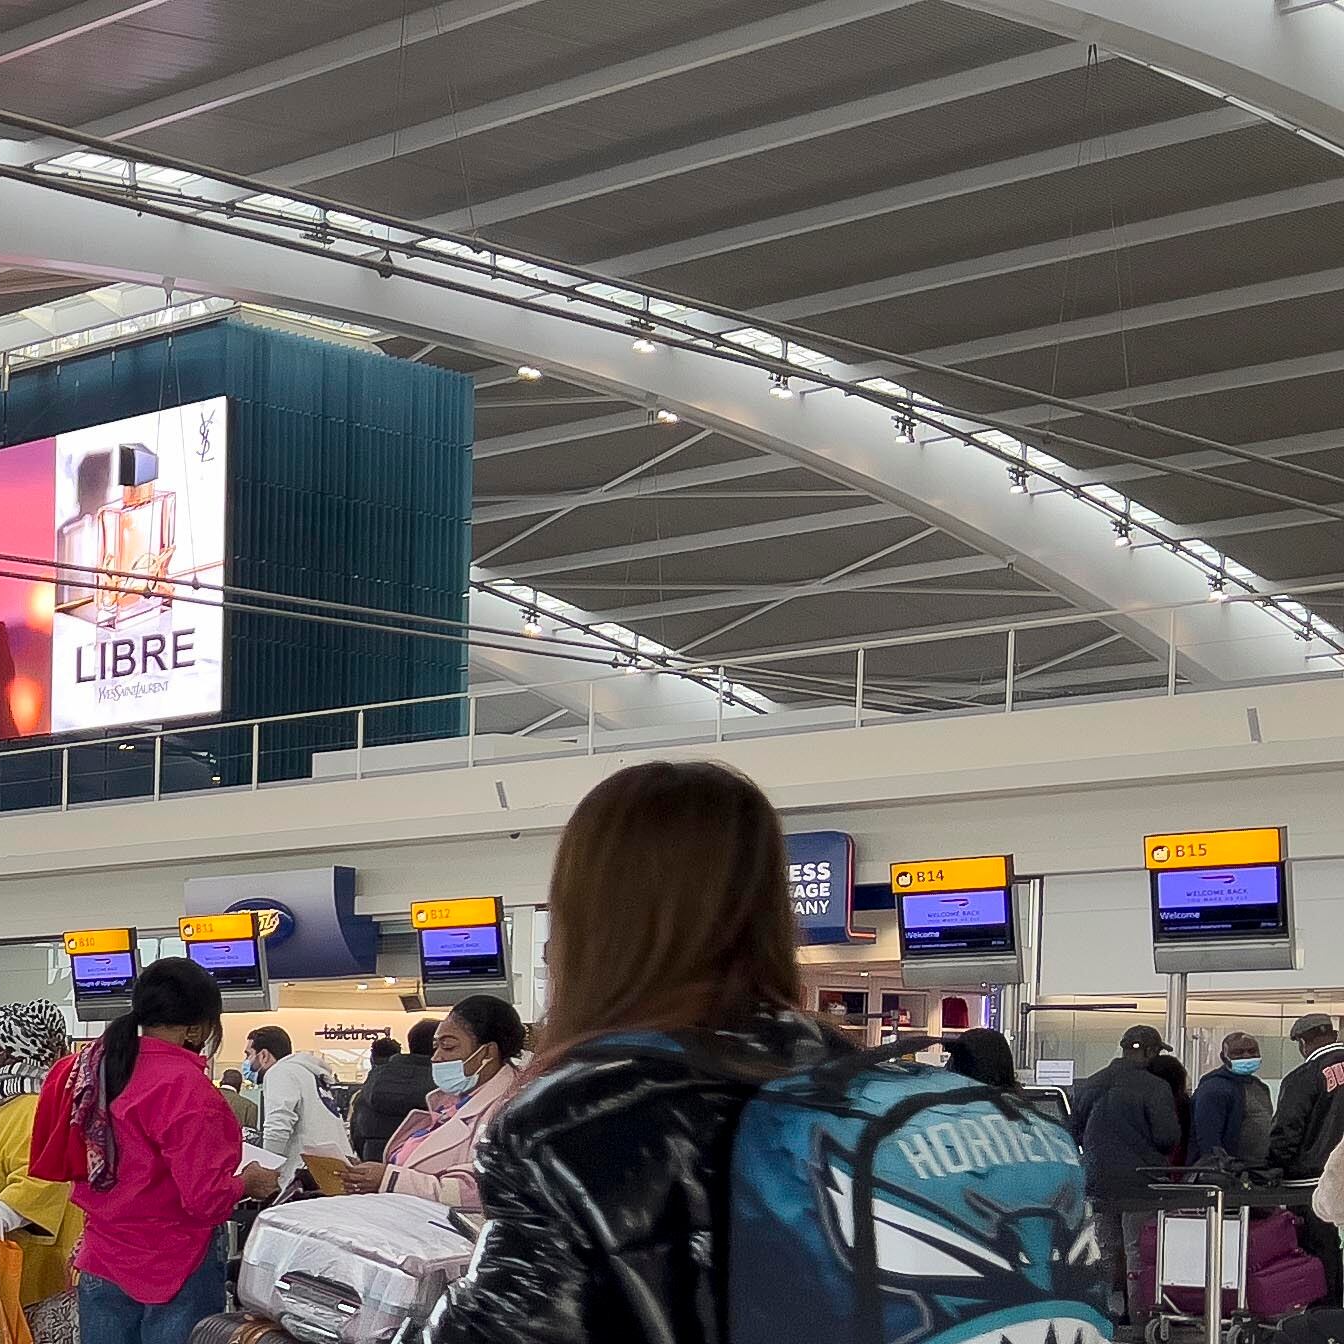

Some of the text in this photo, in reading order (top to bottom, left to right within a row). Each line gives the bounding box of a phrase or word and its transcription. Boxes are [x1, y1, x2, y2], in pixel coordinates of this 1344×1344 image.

[76, 628, 196, 684] LIBRE
[1175, 843, 1207, 858] B15
[788, 861, 831, 882] ESS
[917, 869, 944, 882] B14
[431, 909, 450, 919] B12
[1160, 912, 1200, 920] Welcome
[196, 923, 213, 933] B11
[905, 931, 939, 939] Welcome
[79, 937, 95, 947] B10
[324, 1023, 378, 1041] toiletries
